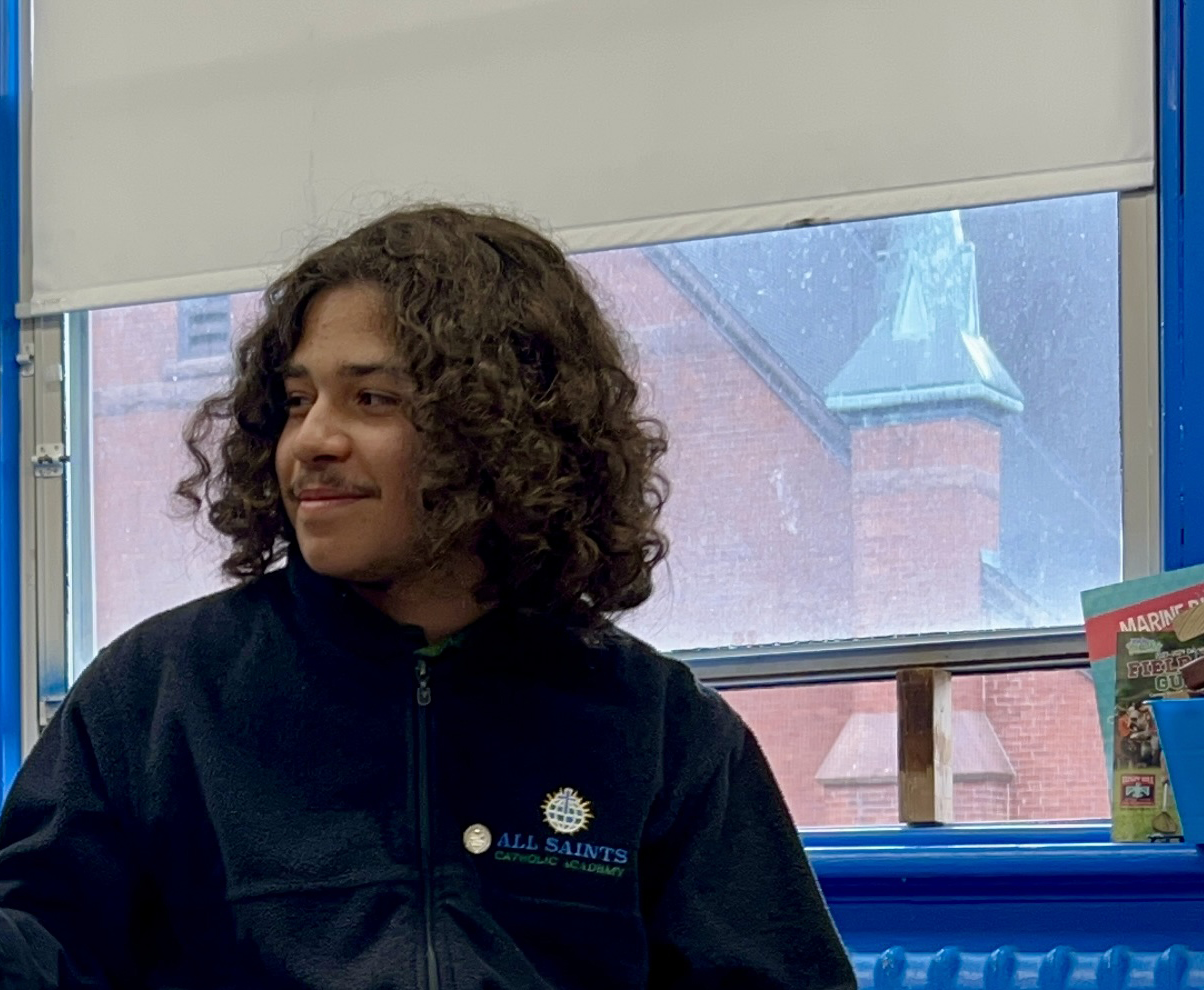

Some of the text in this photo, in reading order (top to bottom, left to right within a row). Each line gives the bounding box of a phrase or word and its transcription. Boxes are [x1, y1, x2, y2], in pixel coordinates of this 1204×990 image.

[496, 832, 628, 864] ALL SAINTS
[494, 850, 625, 878] CATHOLIC ACADEMY
